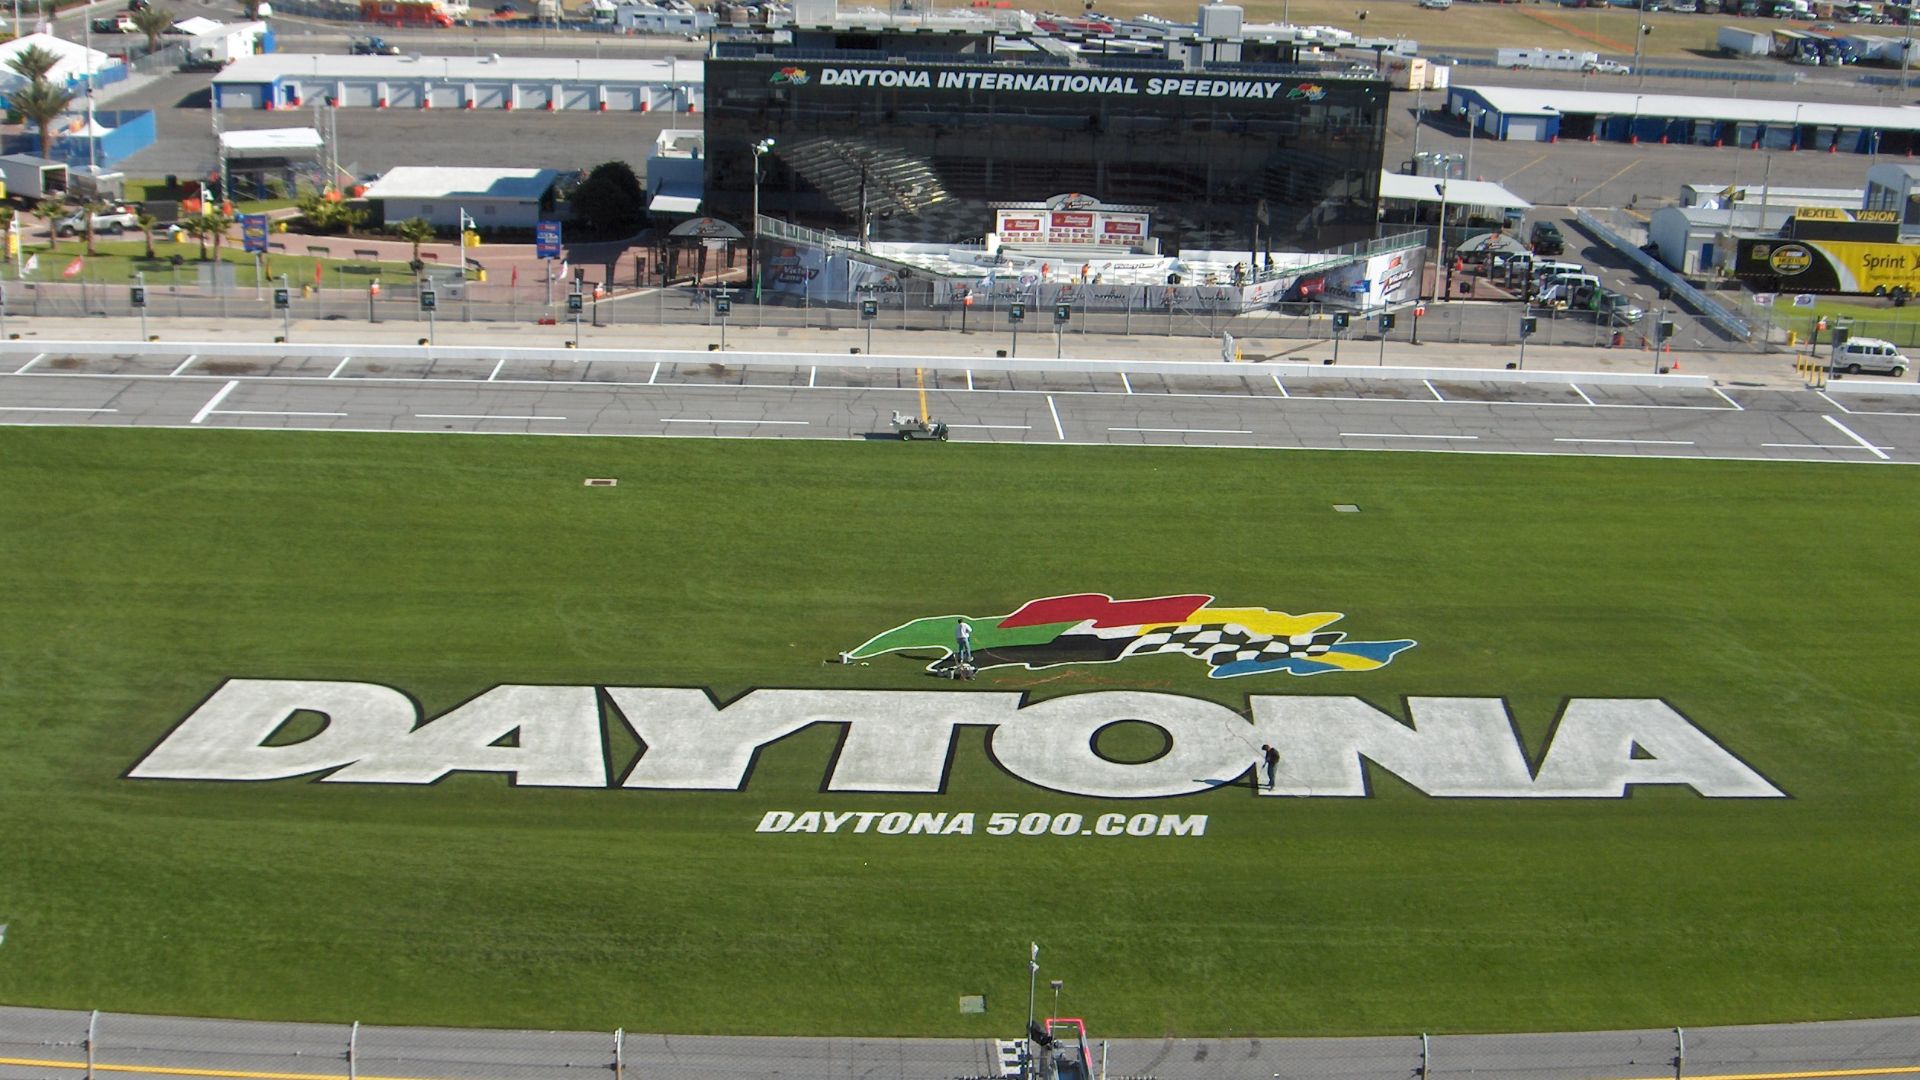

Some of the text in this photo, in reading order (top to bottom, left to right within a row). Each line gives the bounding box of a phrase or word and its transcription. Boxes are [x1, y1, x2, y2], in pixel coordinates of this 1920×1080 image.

[820, 68, 1282, 99] DAYTONA INTERNATIONAL SPEEDWAY
[1797, 208, 1896, 222] NEXTEL VISION
[1863, 253, 1905, 271] Sprint
[125, 677, 1786, 799] DAYTONA
[755, 810, 1208, 836] DAYTONA 500.COM
